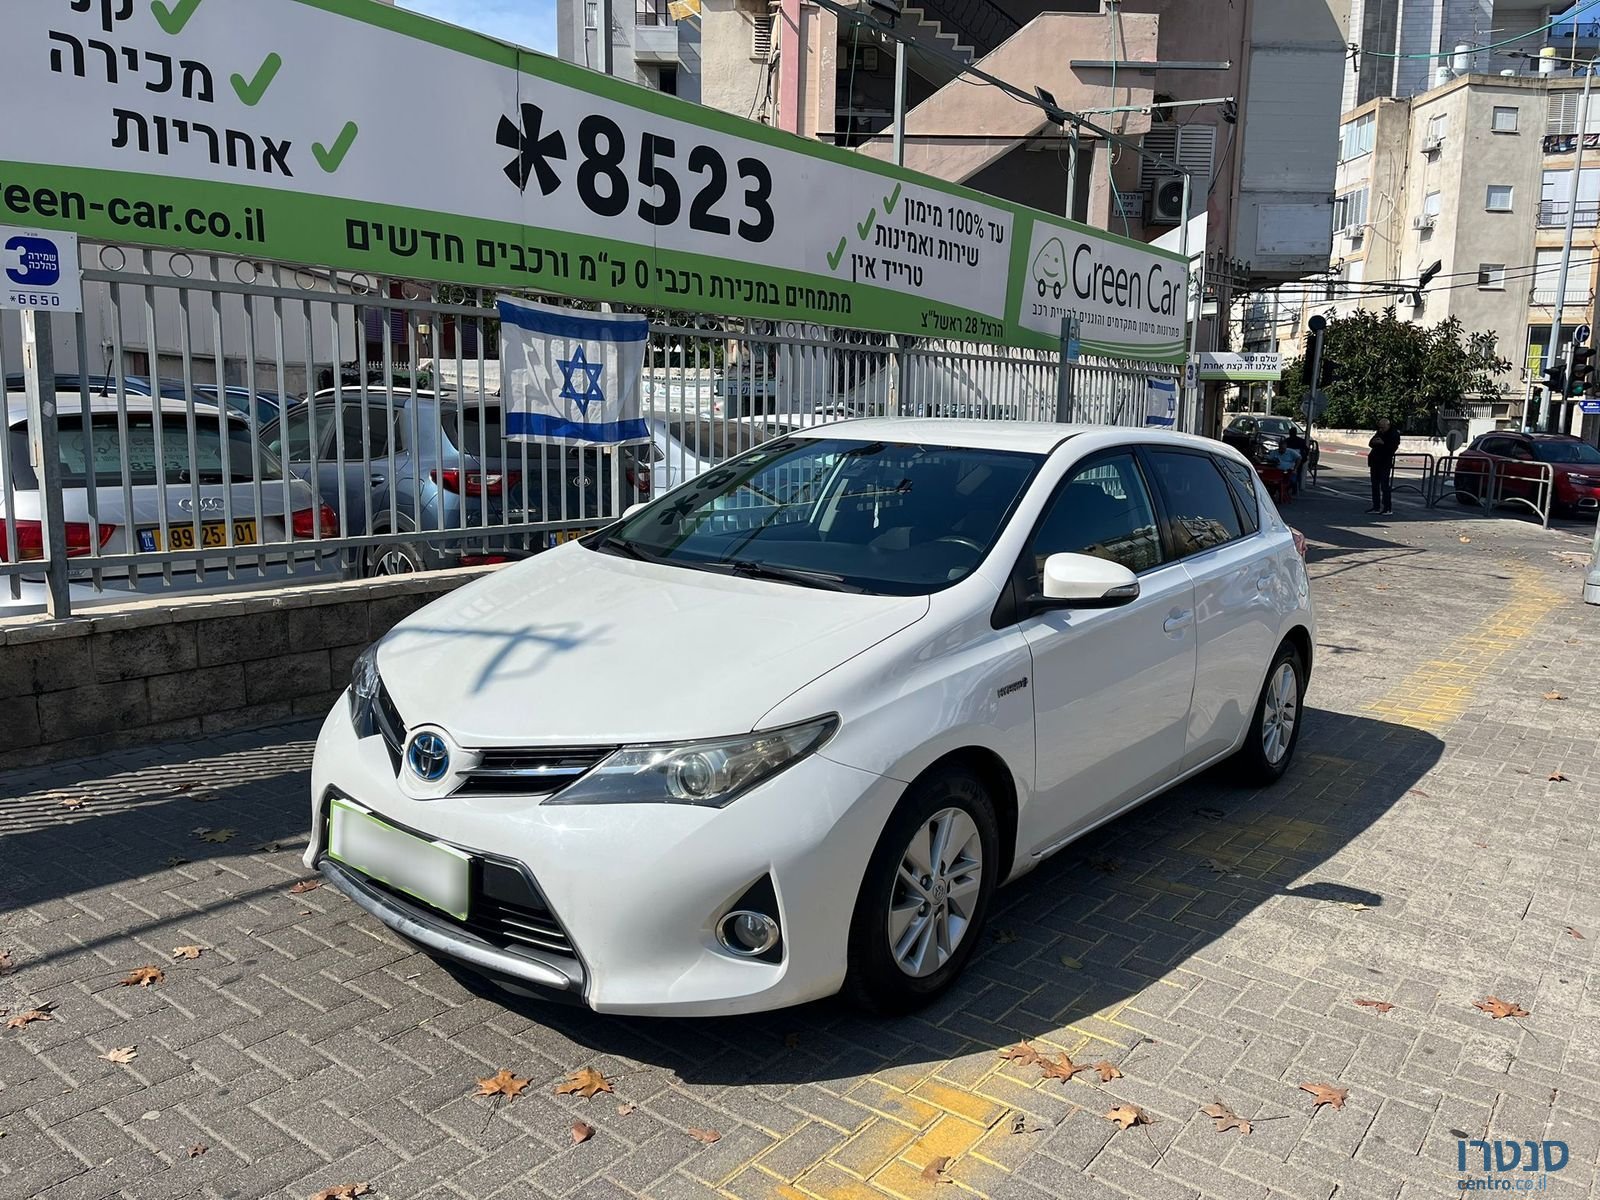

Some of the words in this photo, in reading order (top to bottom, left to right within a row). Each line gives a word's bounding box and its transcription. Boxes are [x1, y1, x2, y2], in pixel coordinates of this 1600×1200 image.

[49, 30, 214, 103] מכירה
[112, 108, 294, 177] אחריות
[0, 183, 265, 243] een-car.co.il
[905, 198, 942, 227] מימון
[948, 207, 984, 239] 100%
[346, 218, 464, 263] חדשים
[875, 224, 933, 257] ואמינות
[988, 222, 1004, 243] עד
[28, 253, 56, 261] שמירה
[29, 261, 57, 270] כהלכה
[476, 239, 569, 277] ורכבים
[938, 239, 979, 266] שירות
[635, 259, 648, 289] 0
[656, 267, 703, 295] רכבי
[852, 254, 876, 282] אין
[882, 260, 923, 287] טרייד
[1073, 243, 1141, 309] Green
[1147, 264, 1181, 316] Car
[709, 275, 780, 305] במכירת
[786, 286, 851, 313] מתמחים
[1032, 303, 1048, 317] רכב
[1080, 312, 1105, 326] והוגנים
[965, 316, 978, 334] 28
[981, 318, 1003, 337] הרצל
[1107, 317, 1137, 332] מתקדמים
[1139, 321, 1155, 335] מימון
[1157, 324, 1180, 337] פתרונות
[1203, 362, 1224, 370] אחרת
[1226, 363, 1243, 371] קצת
[1260, 355, 1278, 363] שלם
